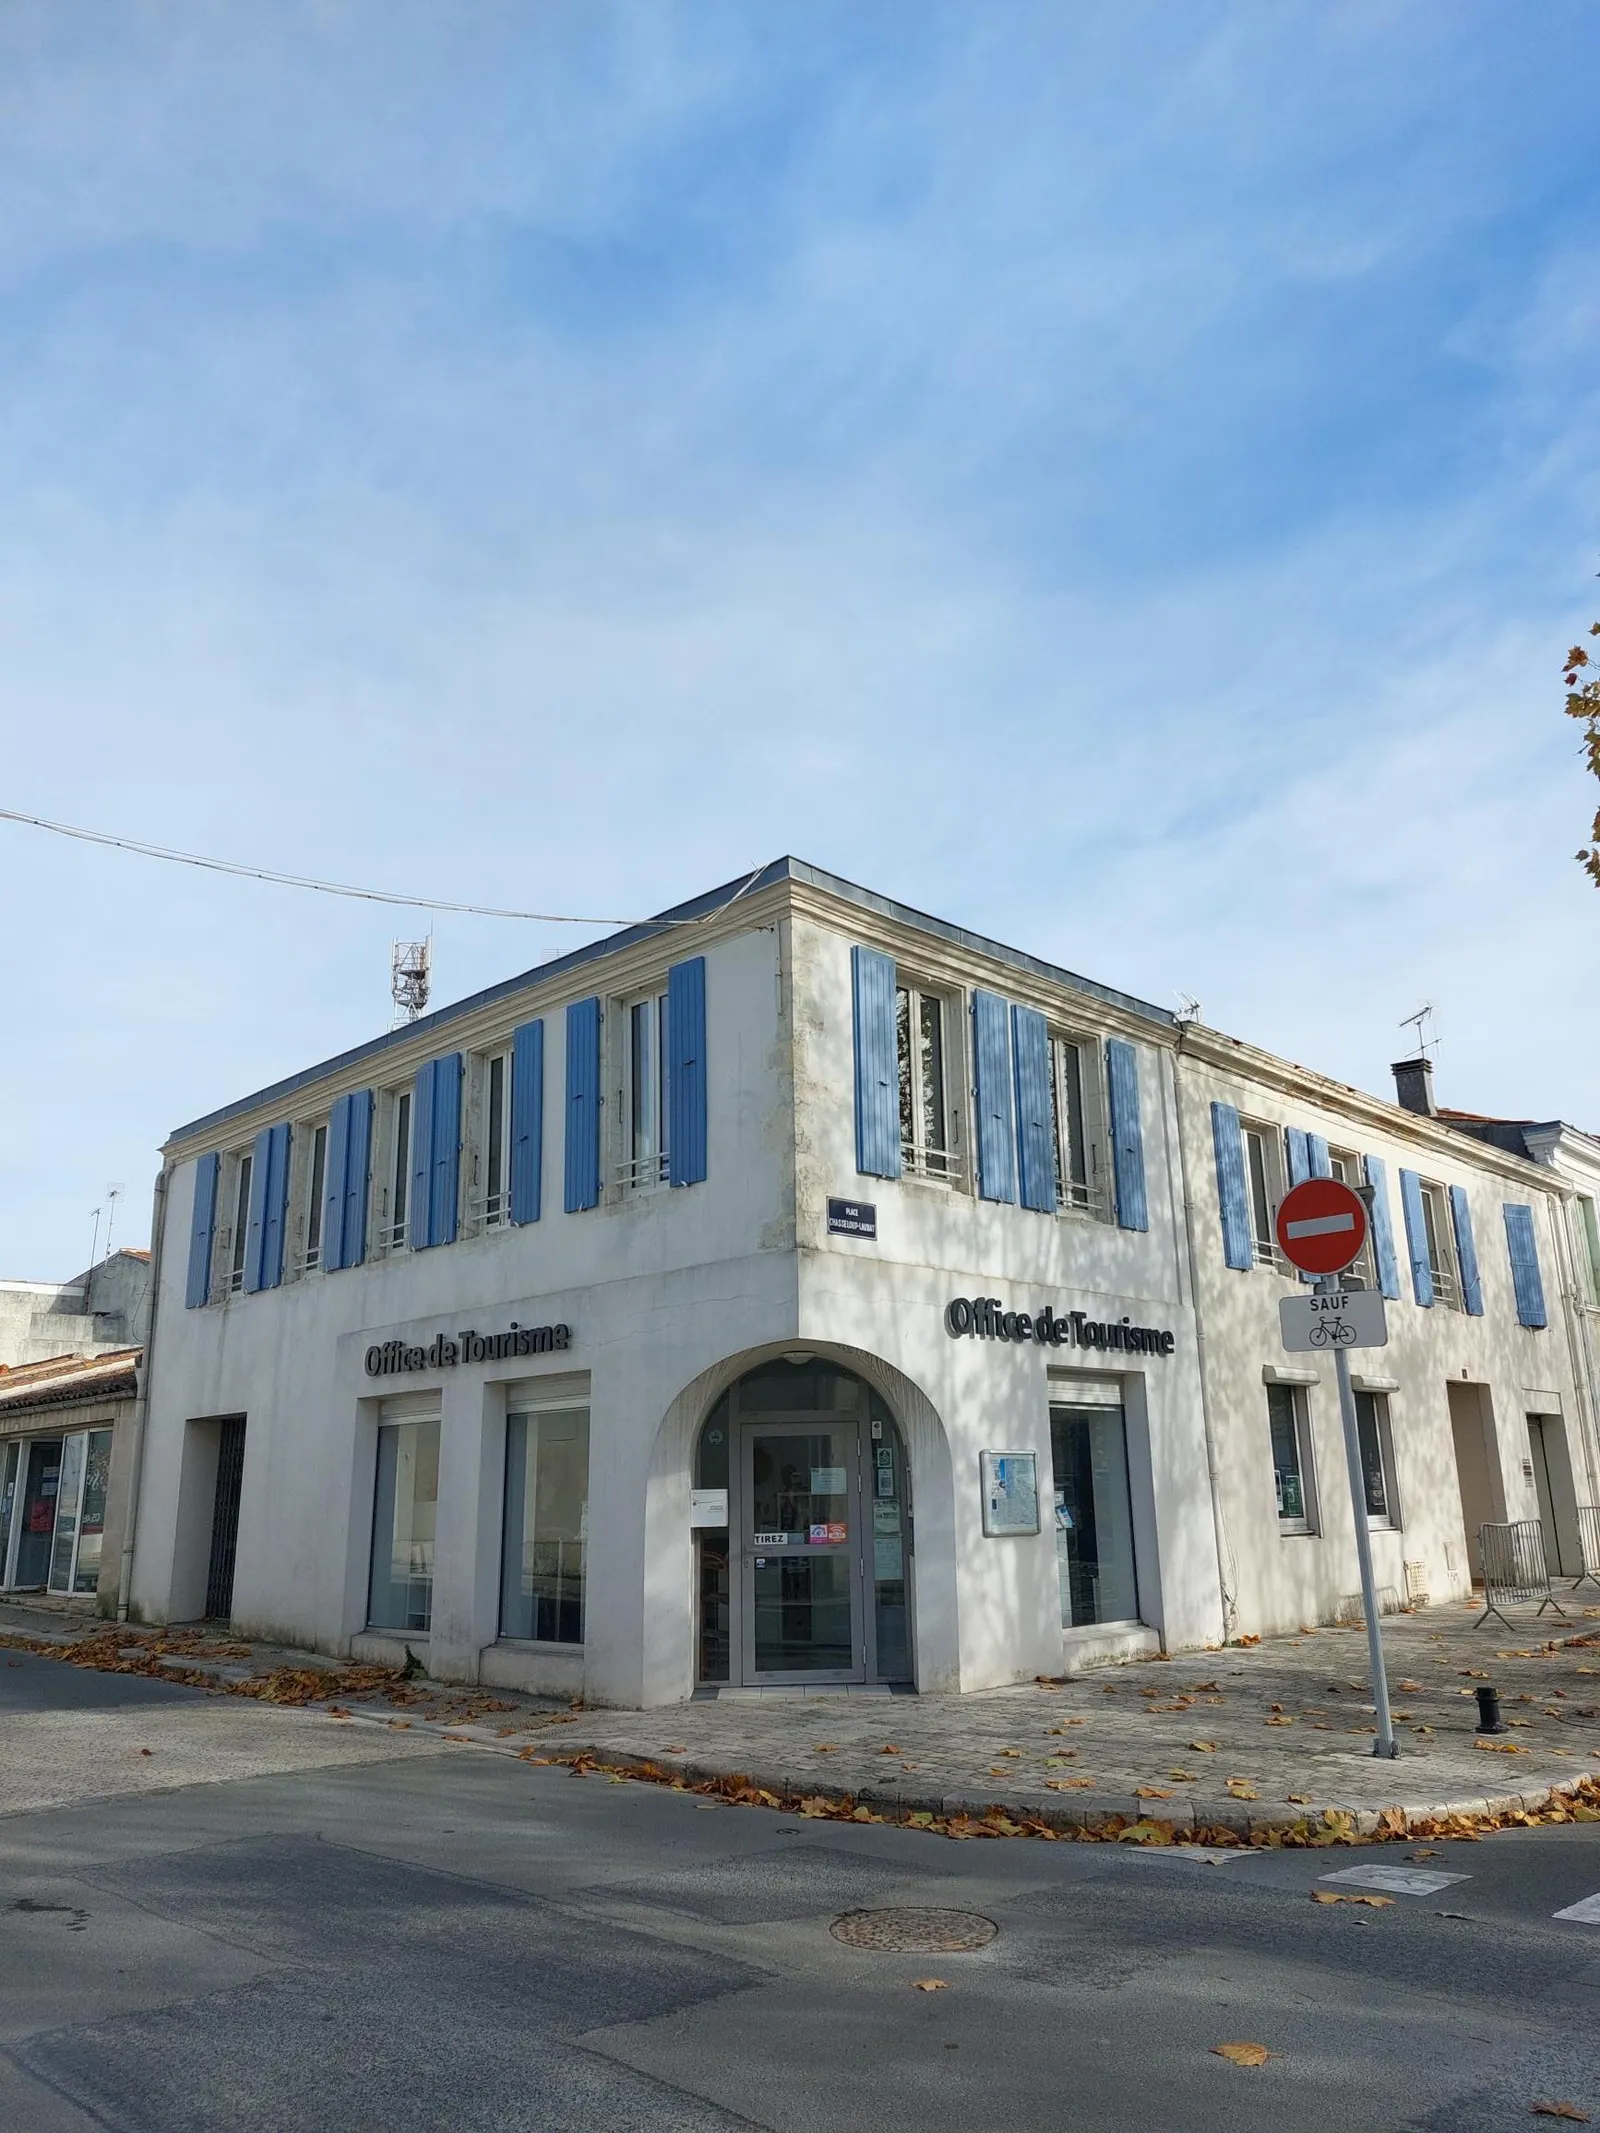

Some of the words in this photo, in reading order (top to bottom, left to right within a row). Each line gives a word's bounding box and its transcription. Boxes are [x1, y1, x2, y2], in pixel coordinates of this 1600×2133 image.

[845, 1207, 859, 1217] PLACE
[1310, 1296, 1349, 1311] SAUF
[950, 1297, 1033, 1339] Office
[1035, 1306, 1069, 1343] de
[1070, 1310, 1175, 1354] Tourisme
[364, 1340, 424, 1377] Office
[427, 1333, 458, 1368] de
[458, 1321, 570, 1363] Tourisme
[754, 1535, 784, 1544] TIREZ
